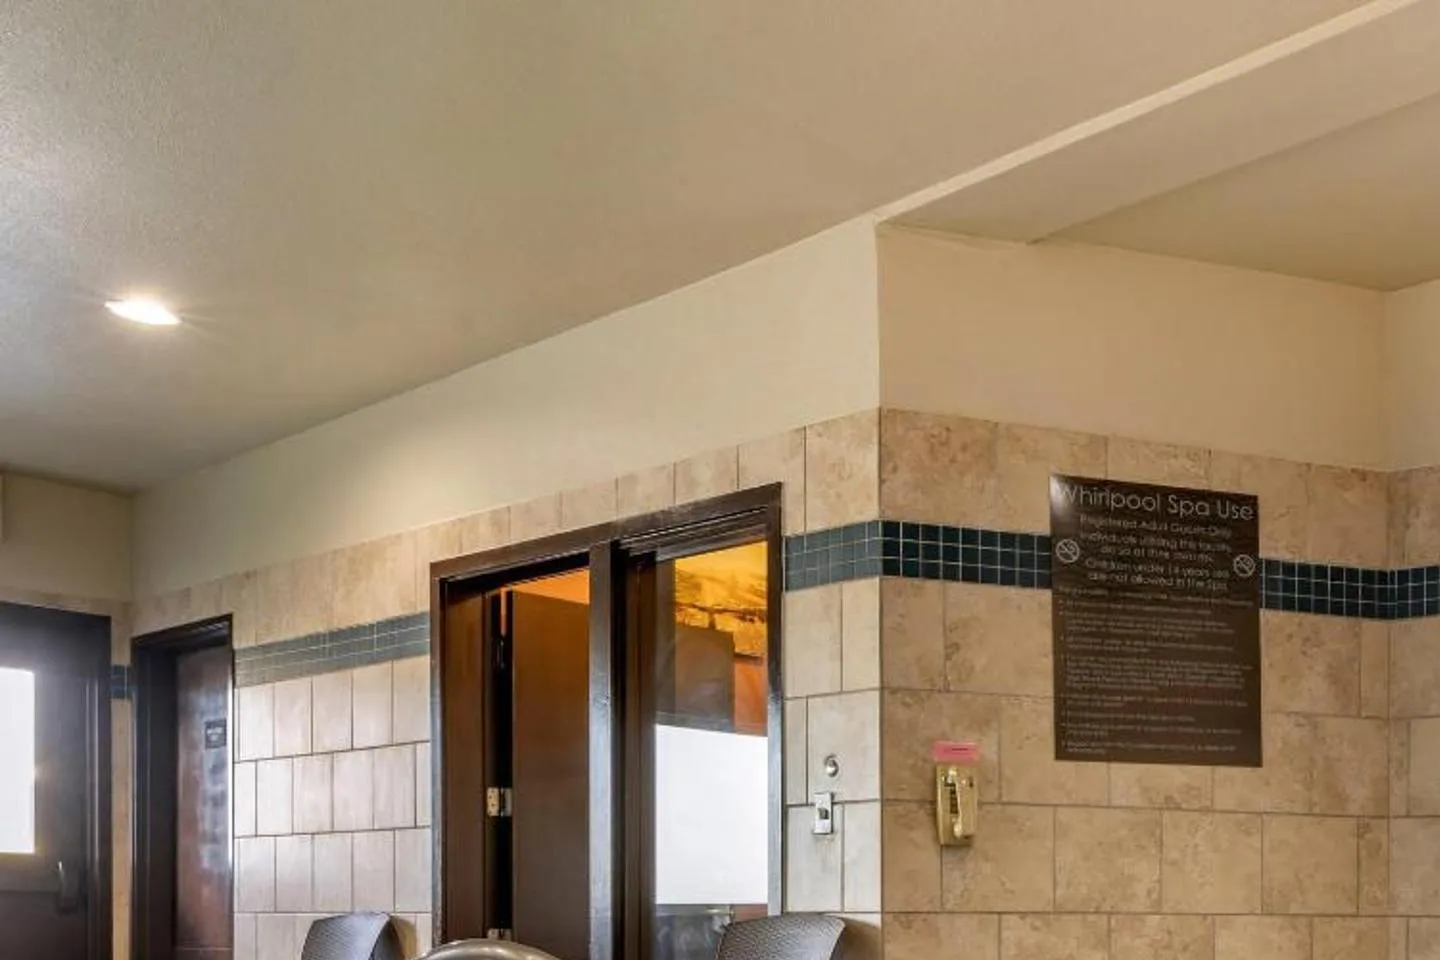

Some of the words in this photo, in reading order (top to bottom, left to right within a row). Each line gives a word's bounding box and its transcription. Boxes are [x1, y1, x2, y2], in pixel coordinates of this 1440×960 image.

[1059, 485, 1161, 512] Whirlpool
[1167, 493, 1210, 519] Spa
[1216, 498, 1254, 521] Use
